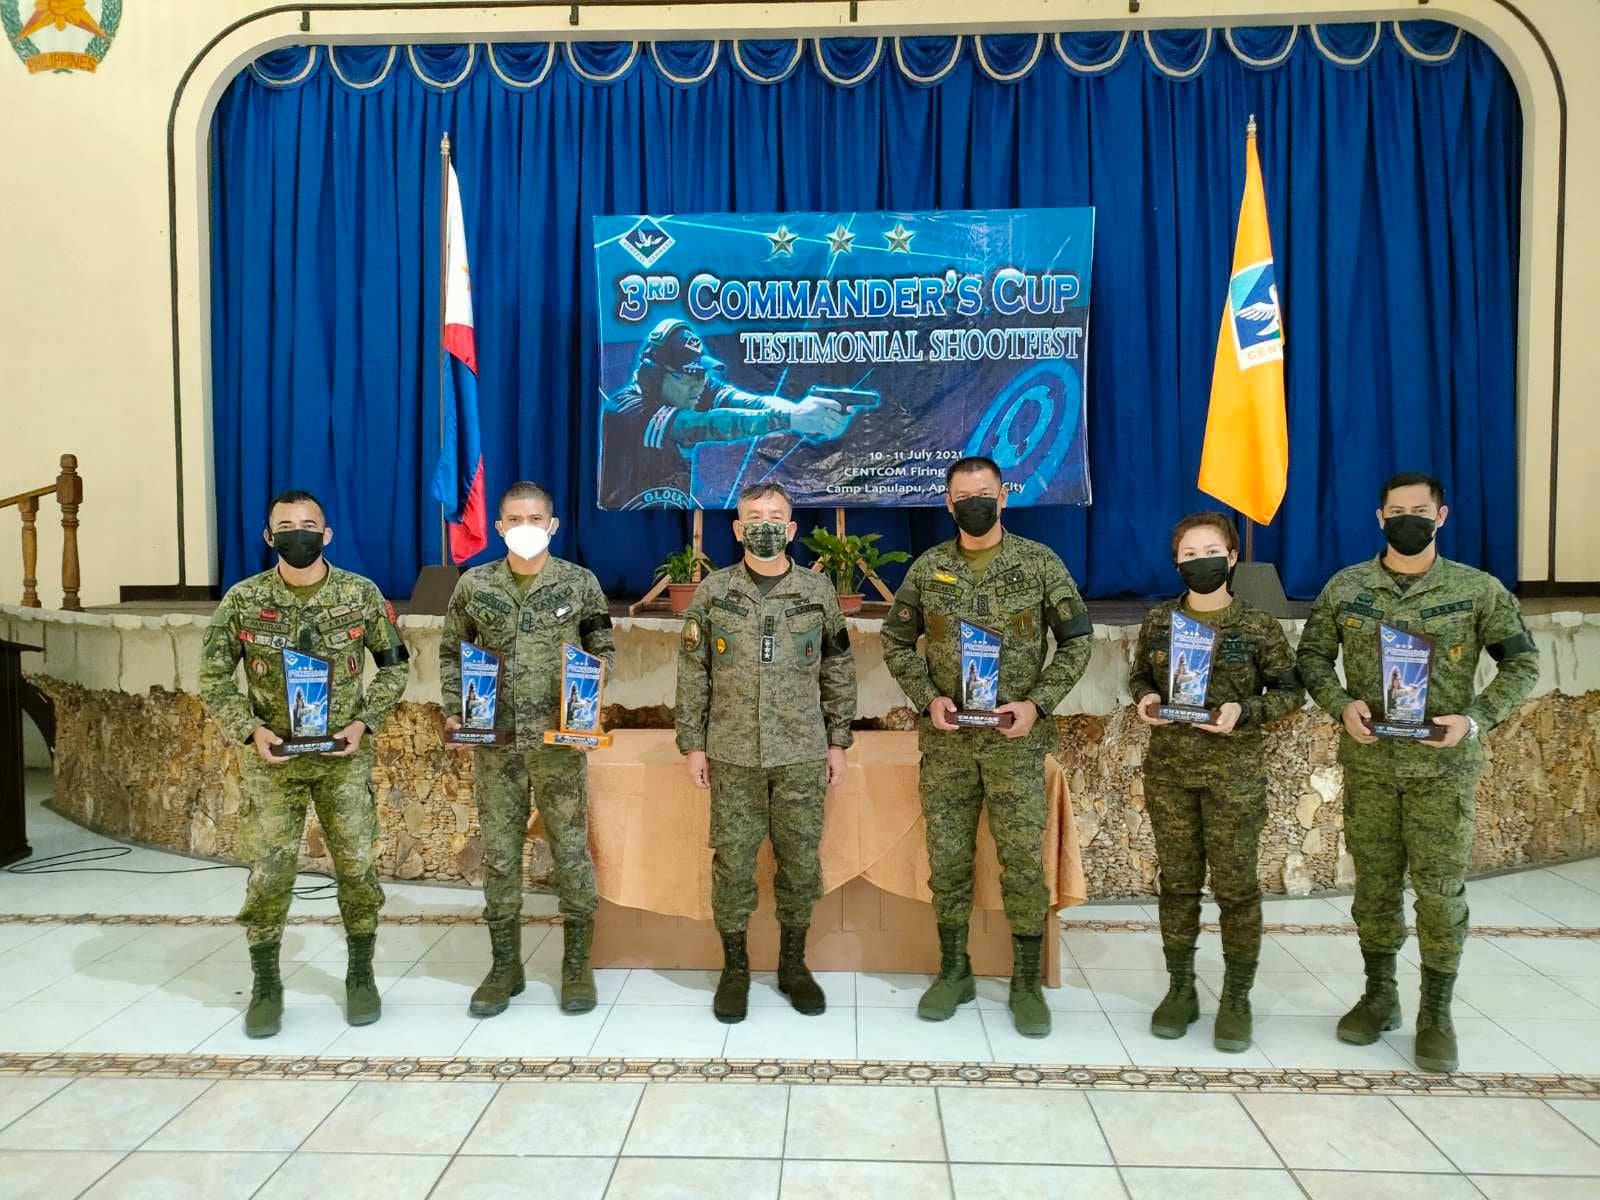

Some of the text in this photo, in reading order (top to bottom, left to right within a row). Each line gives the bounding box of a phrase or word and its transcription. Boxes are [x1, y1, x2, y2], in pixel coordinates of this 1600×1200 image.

[27, 54, 96, 72] PHILIPPINES
[619, 267, 1080, 321] 3RD COMMANDER'S CUP
[740, 327, 1083, 364] TESTIMONIAL SHOOTFEST
[869, 451, 882, 460] 10
[893, 451, 904, 460] 11
[907, 449, 933, 461] July
[936, 450, 963, 461] 2021
[844, 466, 946, 478] CENTCOM Firing
[826, 482, 1026, 495] Camp Lapulapu, Ap City
[644, 490, 683, 504] GLOCK
[1003, 579, 1032, 593] ARMY
[1432, 601, 1464, 614] ARMY
[328, 614, 354, 628] ARMY
[1163, 708, 1208, 717] CHAMPION
[286, 741, 334, 750] CHAMPION
